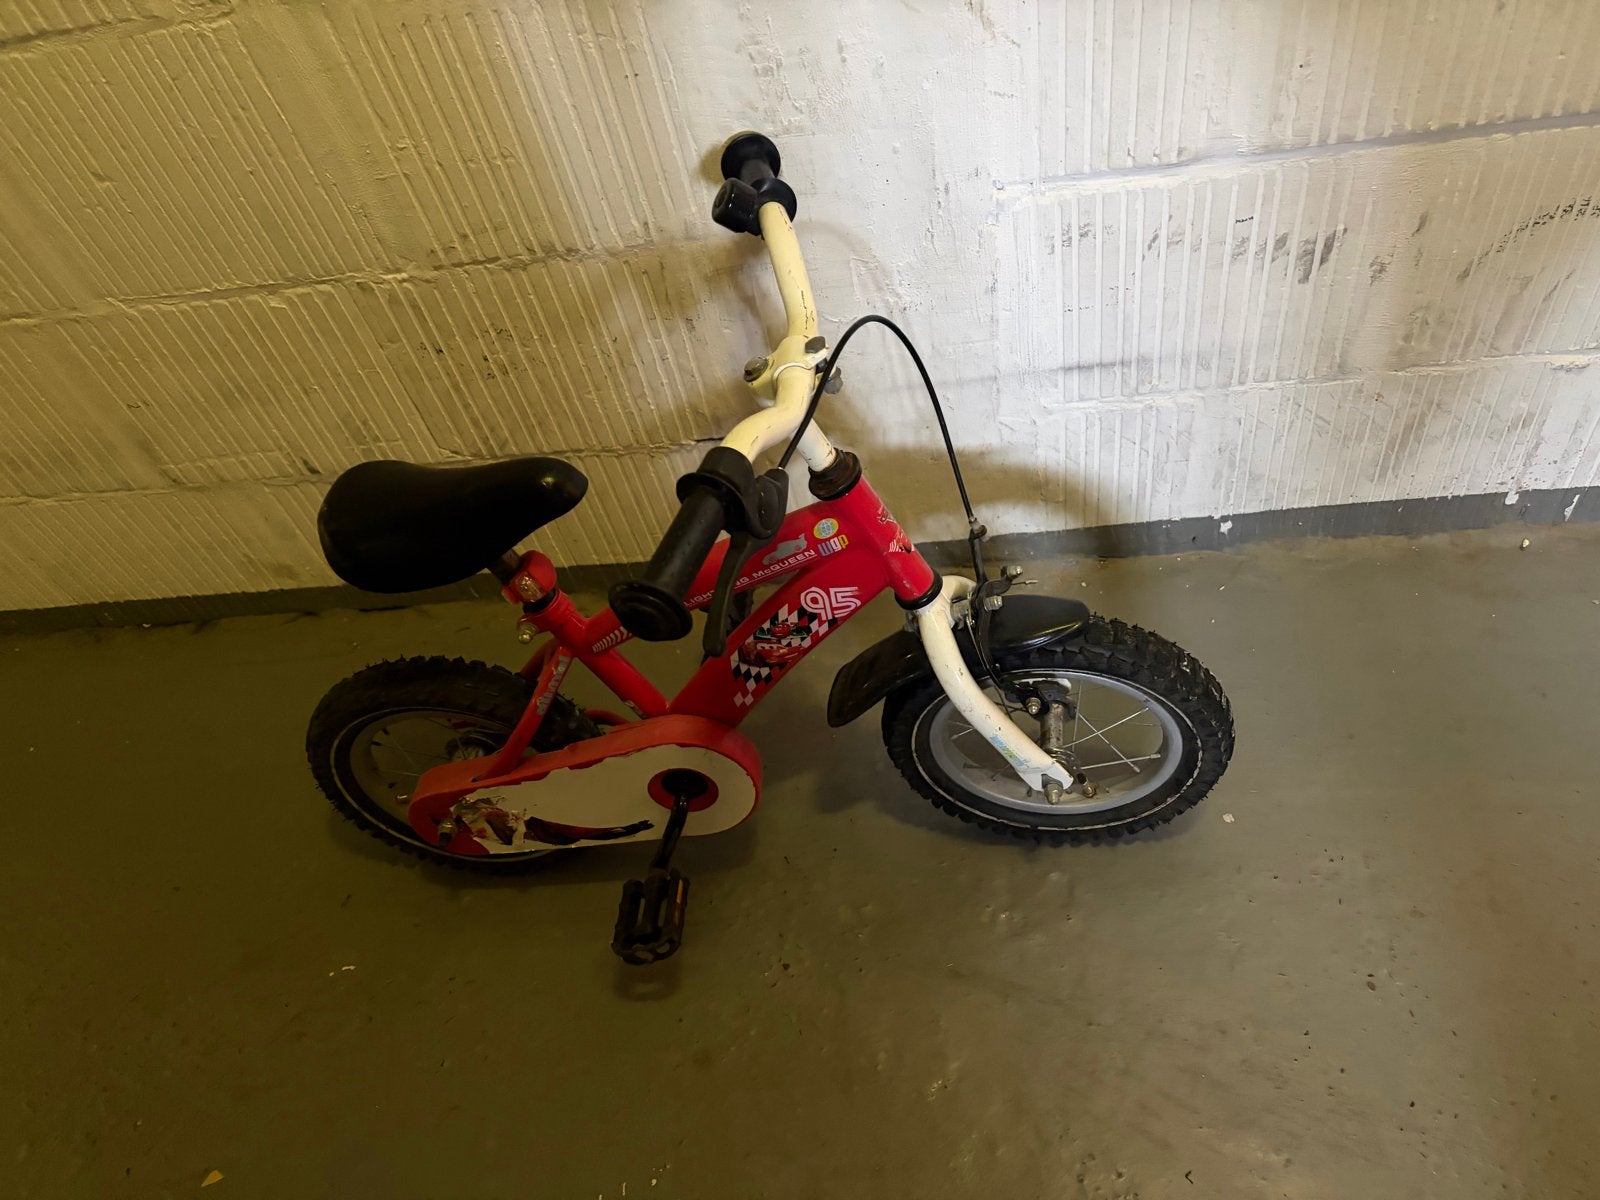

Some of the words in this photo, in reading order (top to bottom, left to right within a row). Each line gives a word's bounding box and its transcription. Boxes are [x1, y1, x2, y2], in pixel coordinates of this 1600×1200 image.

[683, 576, 750, 607] LIGHG
[752, 549, 817, 579] McQUEEN
[800, 586, 862, 621] 95
